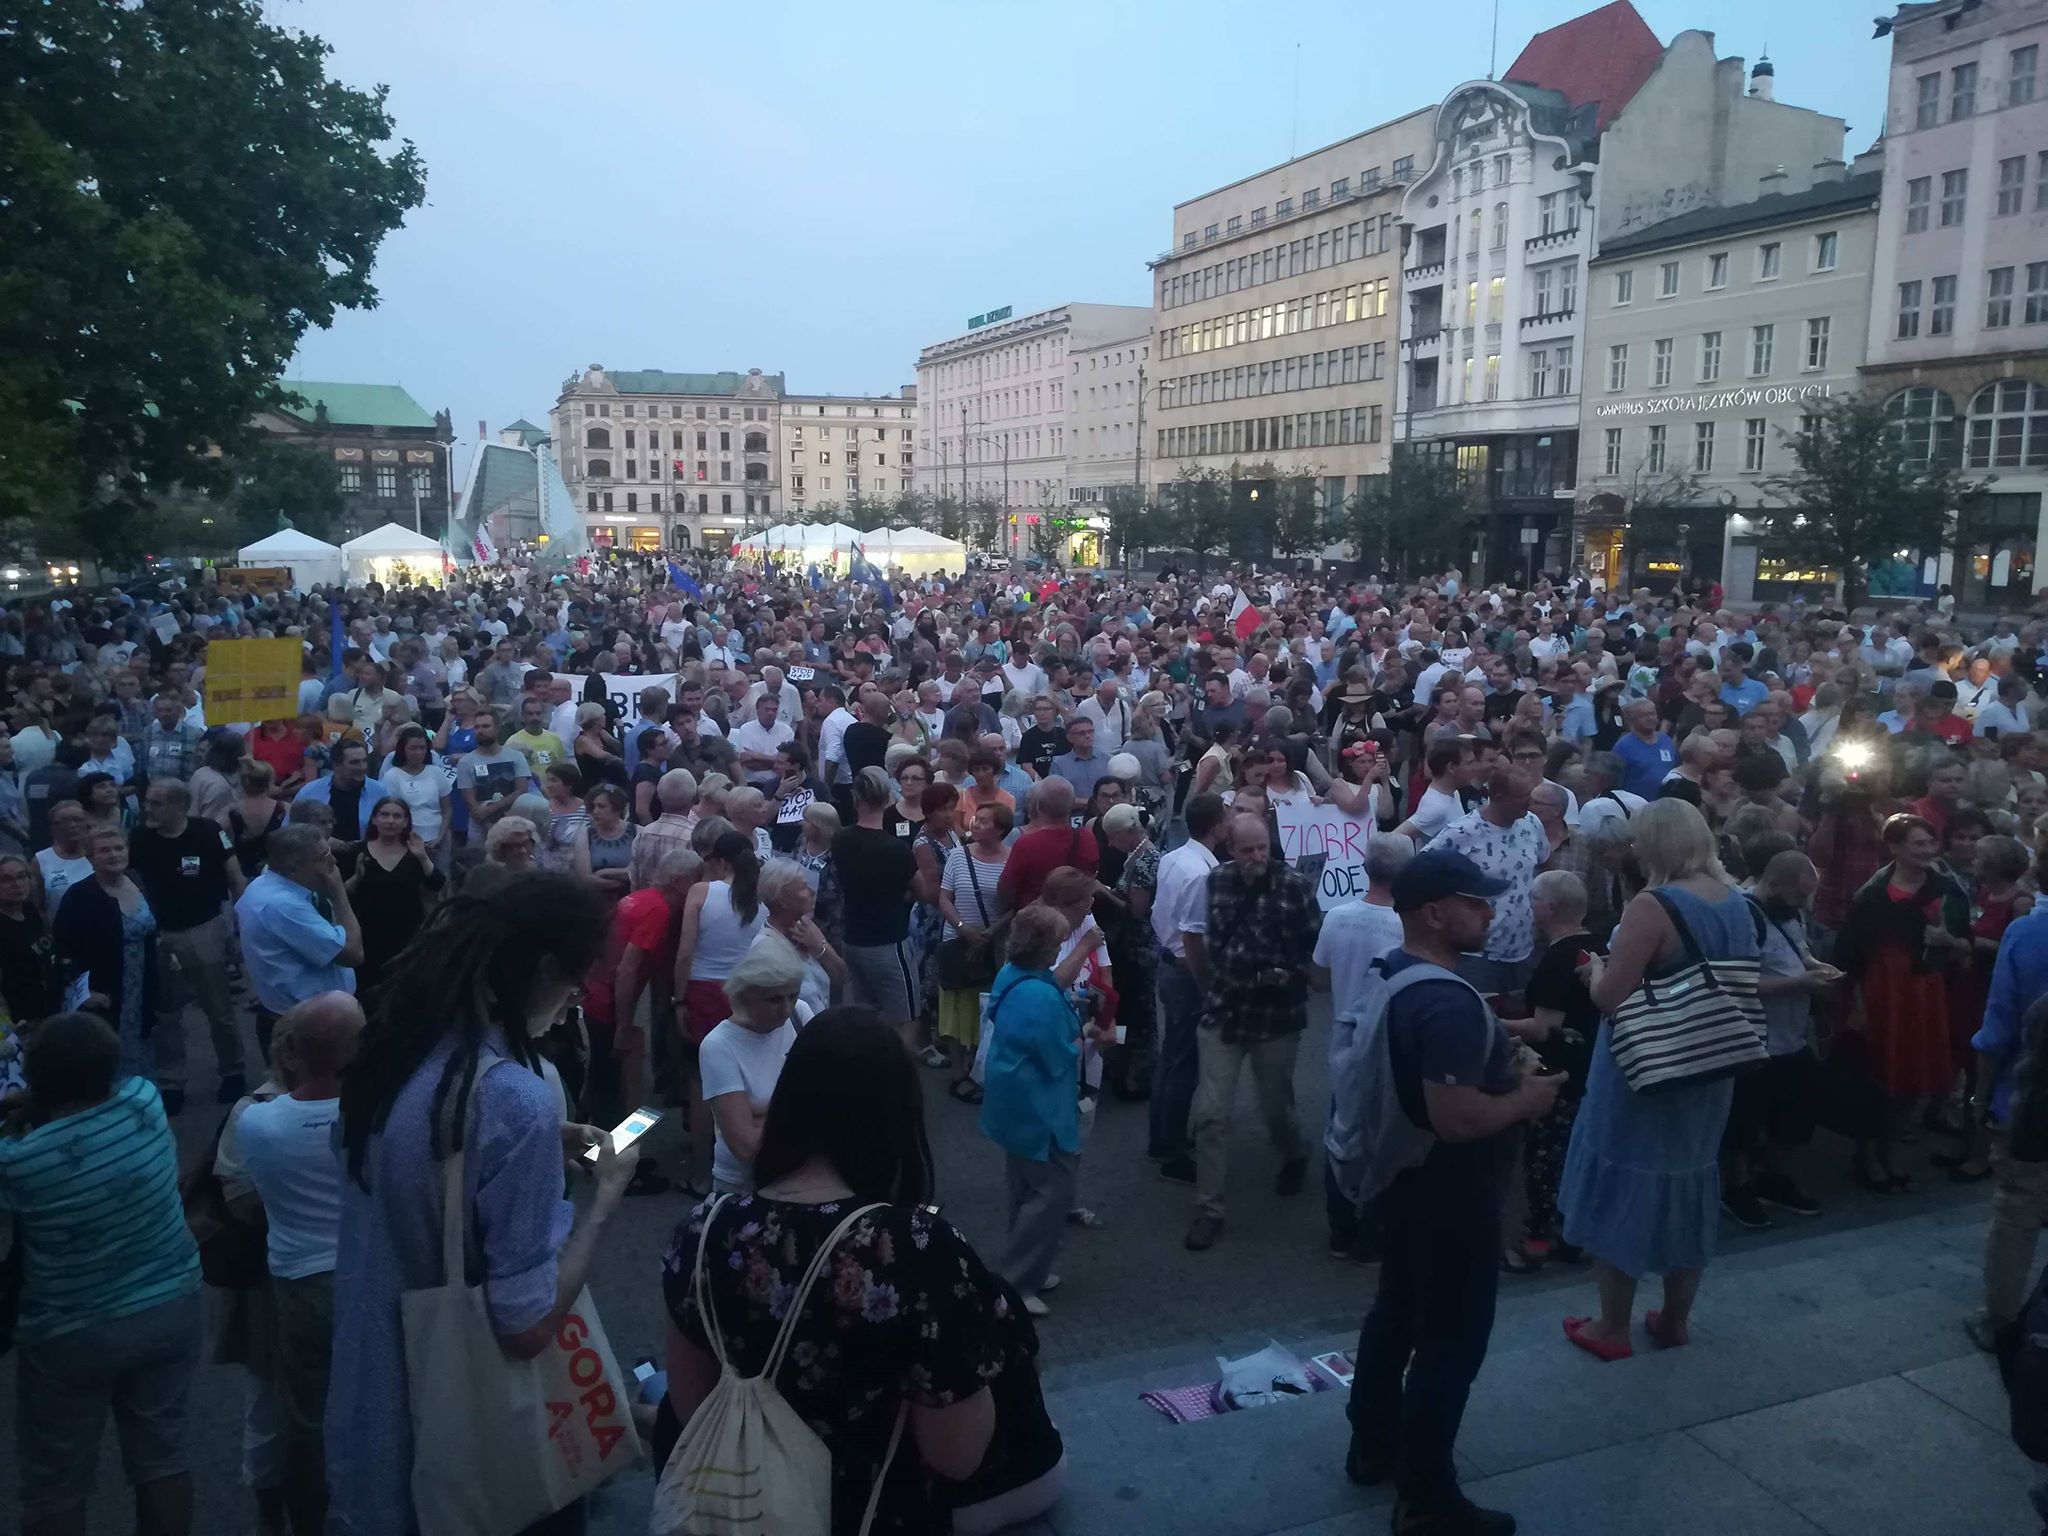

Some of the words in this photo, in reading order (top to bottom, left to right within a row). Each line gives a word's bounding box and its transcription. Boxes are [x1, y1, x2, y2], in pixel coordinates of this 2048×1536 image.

[1597, 401, 1643, 416] OMNIBUS
[792, 667, 813, 675] STOP
[781, 791, 812, 807] STOP
[780, 803, 807, 817] HAT
[1322, 864, 1368, 898] ODE
